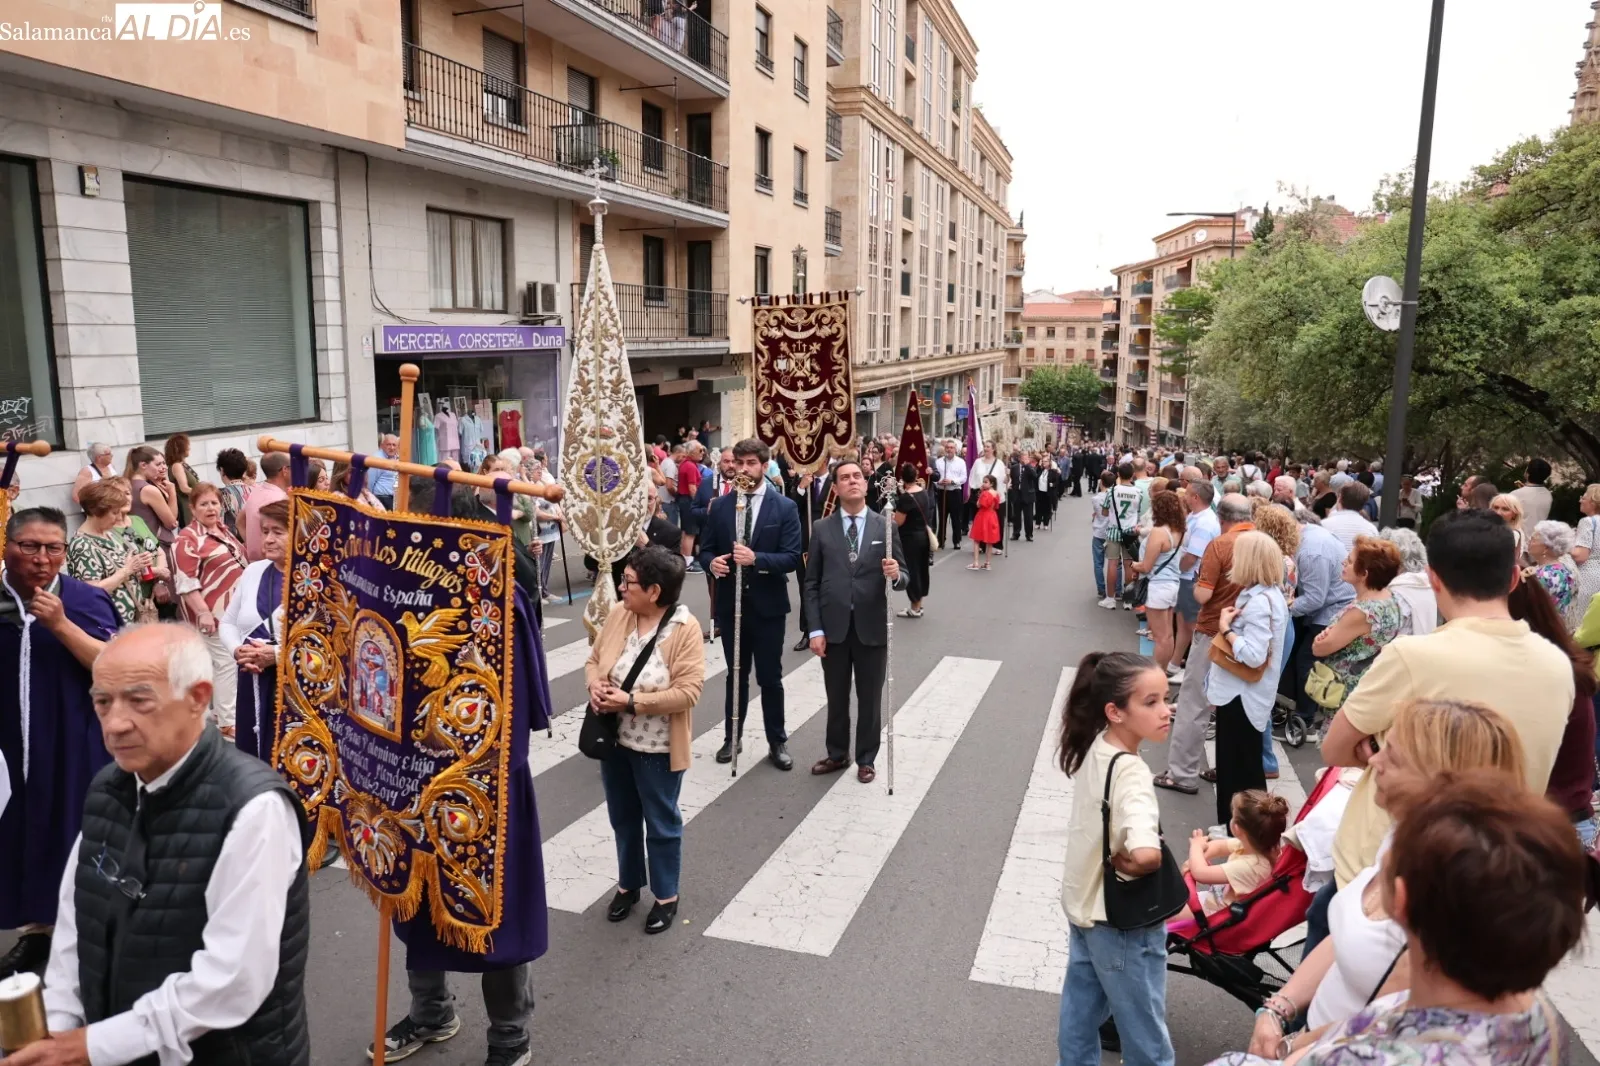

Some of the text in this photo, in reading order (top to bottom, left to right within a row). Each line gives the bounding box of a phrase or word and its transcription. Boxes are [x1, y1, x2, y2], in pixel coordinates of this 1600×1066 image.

[387, 328, 453, 350] MERCERÍA
[457, 329, 525, 349] CORSETERÍA
[532, 331, 563, 347] Duna
[1119, 501, 1131, 519] 7
[392, 546, 464, 593] Milagros
[382, 584, 434, 610] España
[410, 753, 436, 779] hija
[373, 763, 420, 797] Mendoza
